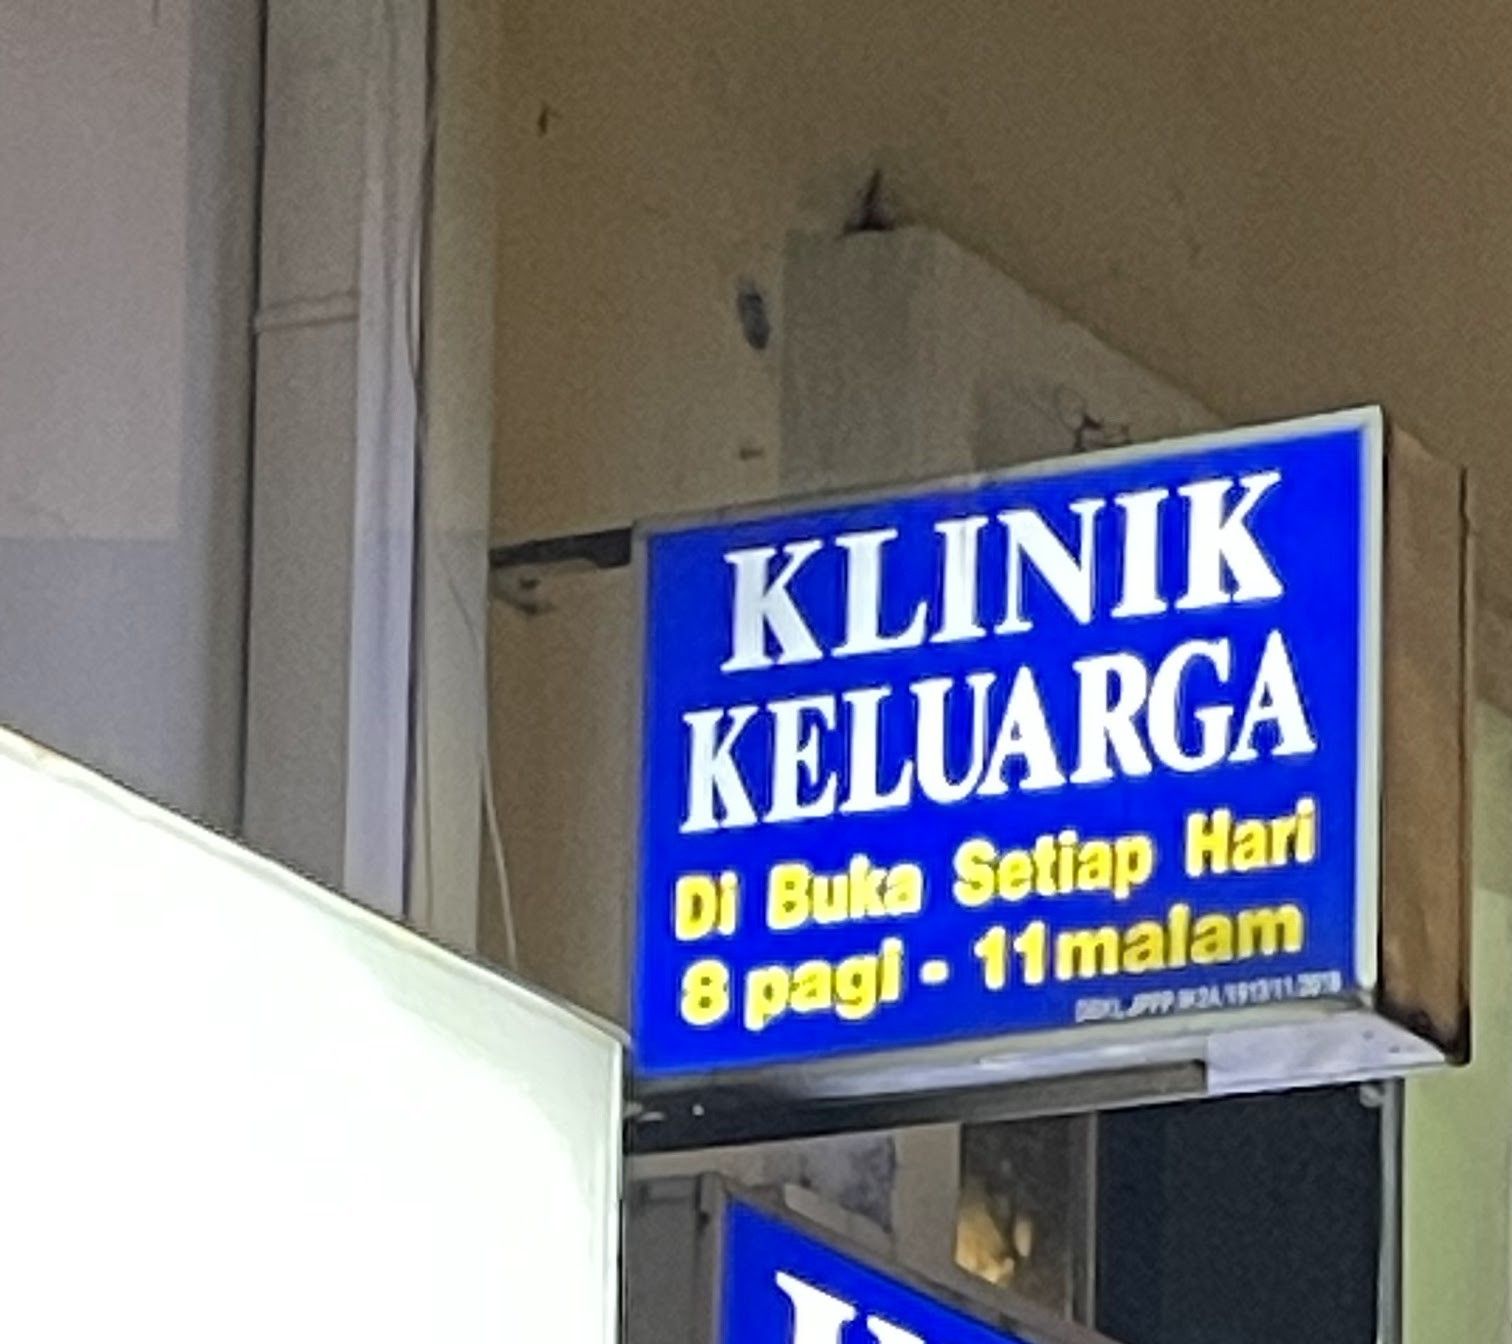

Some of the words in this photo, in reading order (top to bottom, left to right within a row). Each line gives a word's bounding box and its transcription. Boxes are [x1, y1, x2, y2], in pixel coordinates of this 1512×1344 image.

[721, 471, 1283, 675] KLINIK
[680, 630, 1316, 832] KELUARGA
[675, 872, 737, 941] Di
[766, 854, 922, 930] Buka
[952, 829, 1153, 906] Setiap
[1185, 806, 1315, 877] Hari
[680, 960, 730, 1025] 8
[745, 938, 904, 1032] pagi
[973, 904, 1302, 990] 11malam
